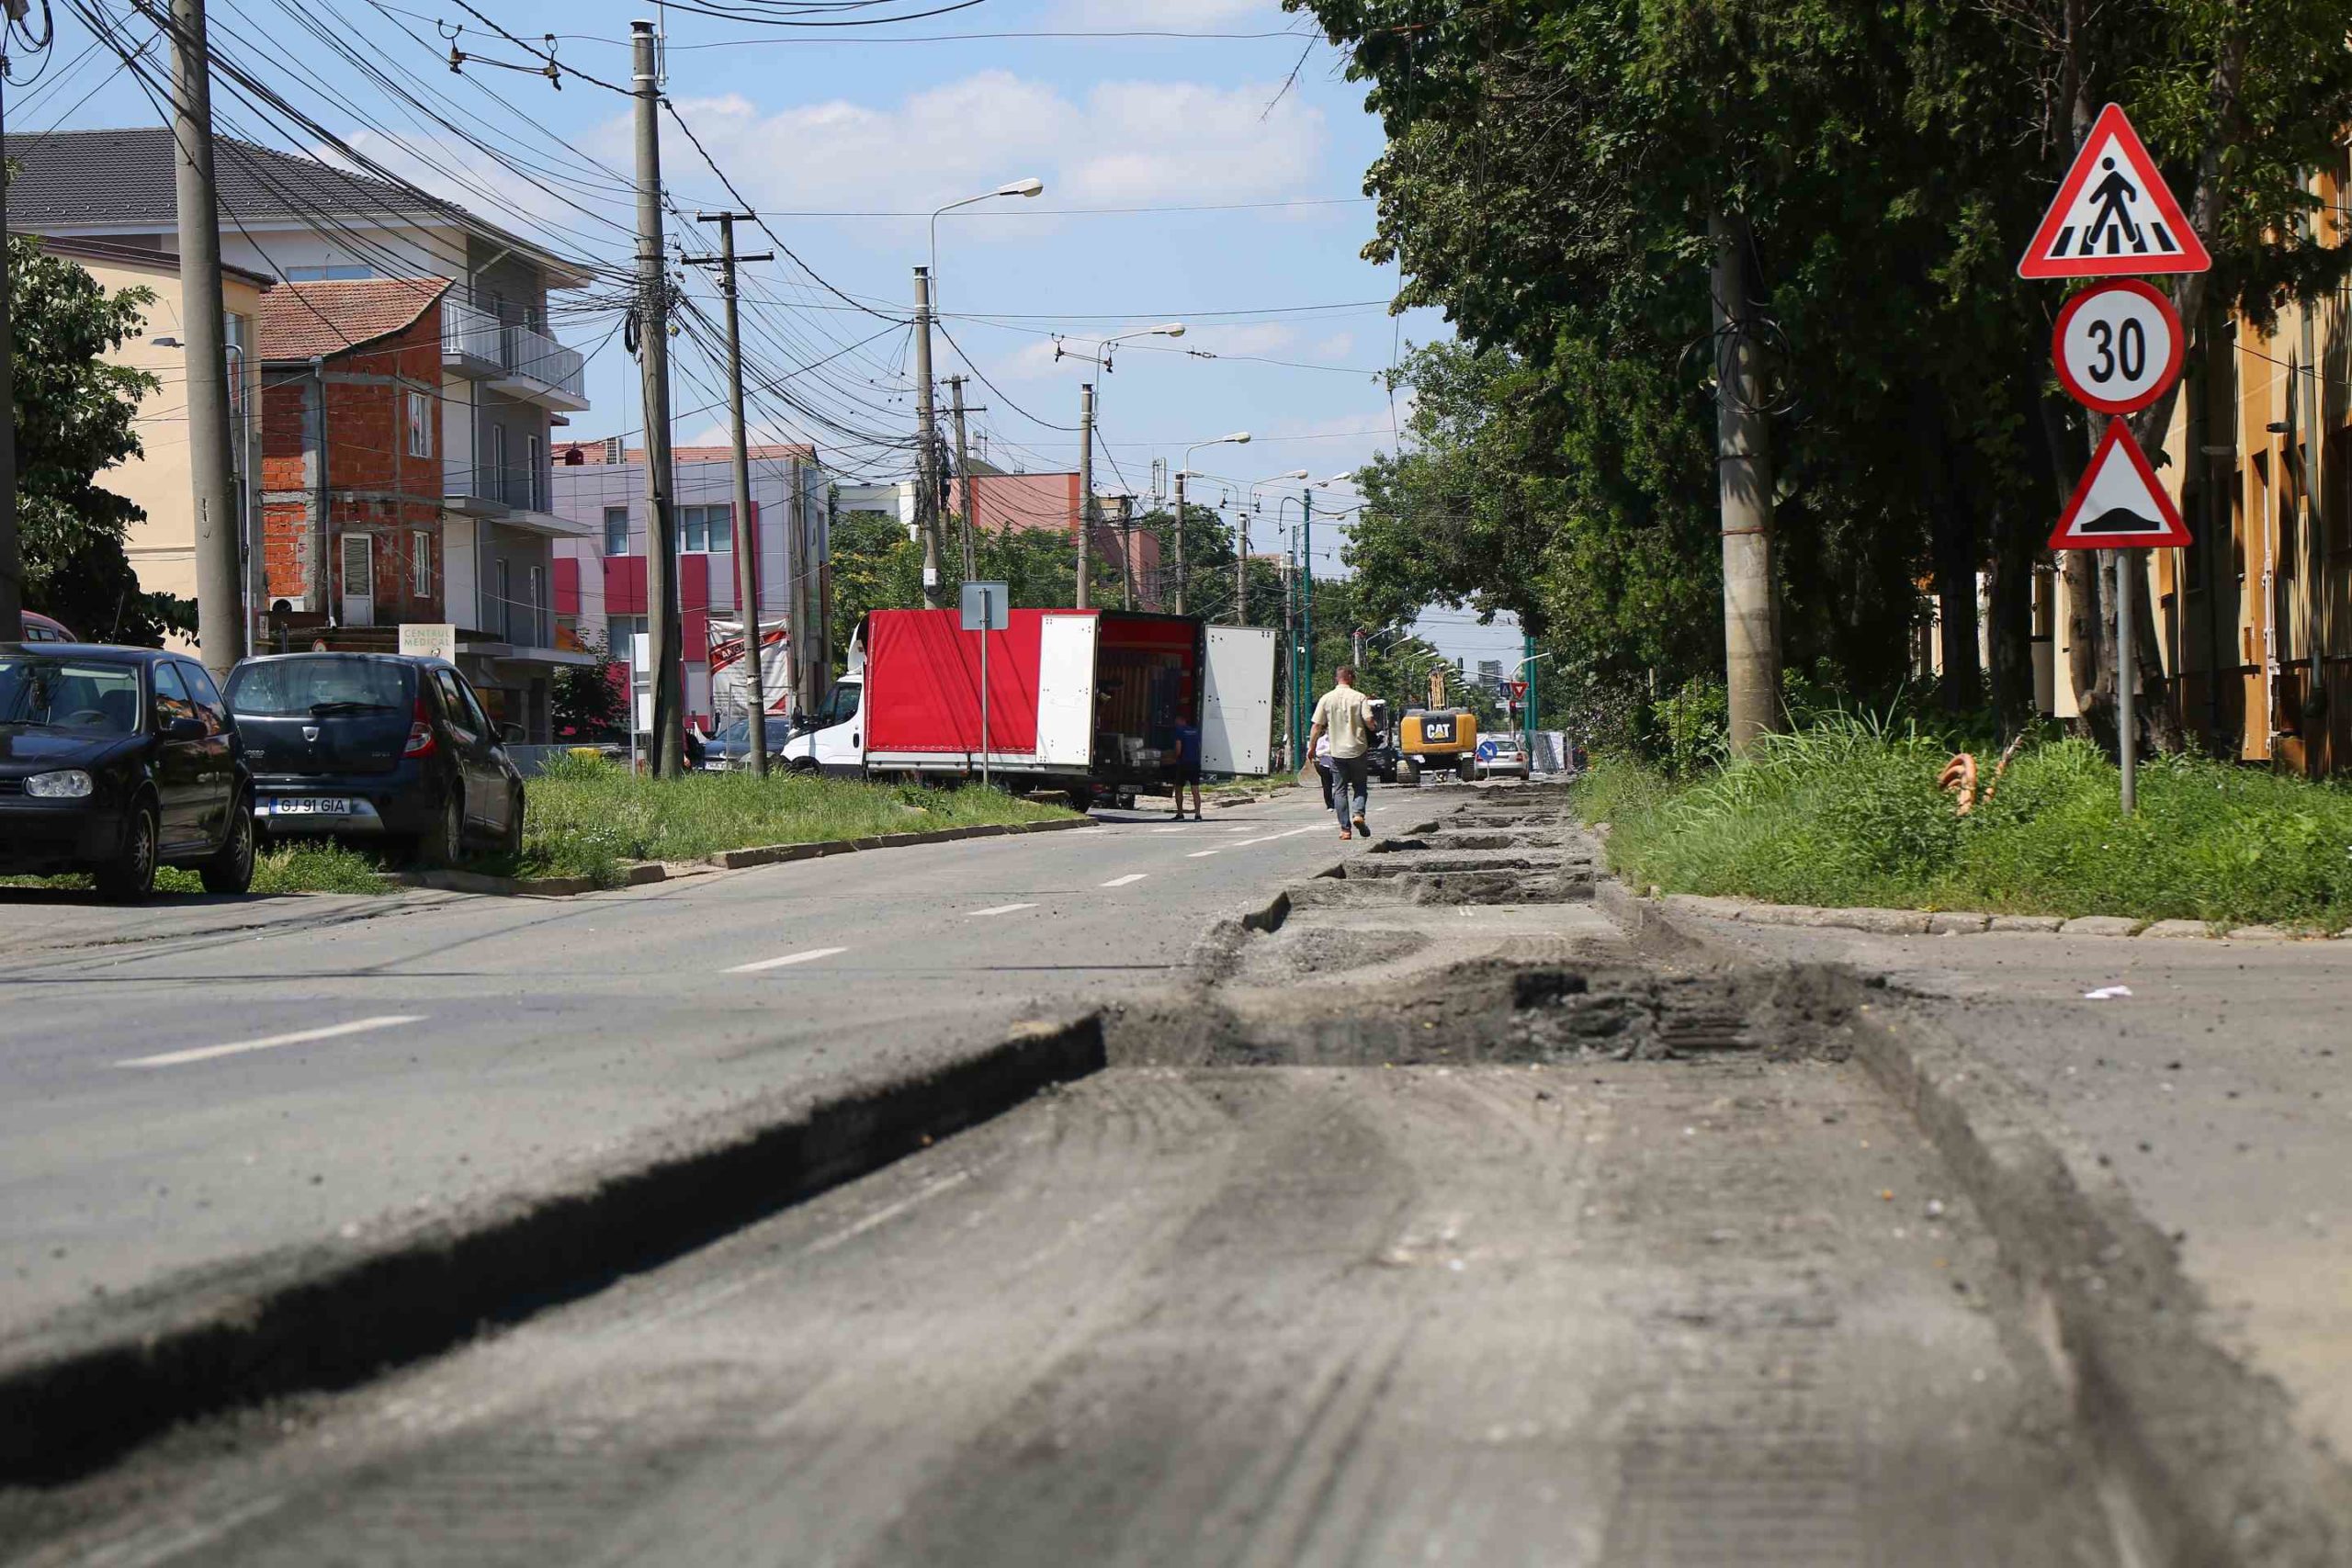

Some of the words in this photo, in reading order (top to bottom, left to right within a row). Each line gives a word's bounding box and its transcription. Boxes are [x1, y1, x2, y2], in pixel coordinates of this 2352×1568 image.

[2088, 318, 2145, 383] 30
[404, 628, 450, 637] CENTRUL
[404, 638, 450, 647] MEDICAL
[1427, 723, 1450, 739] CAT
[281, 799, 299, 812] GJ
[303, 799, 316, 812] 91
[322, 799, 345, 812] GIA
